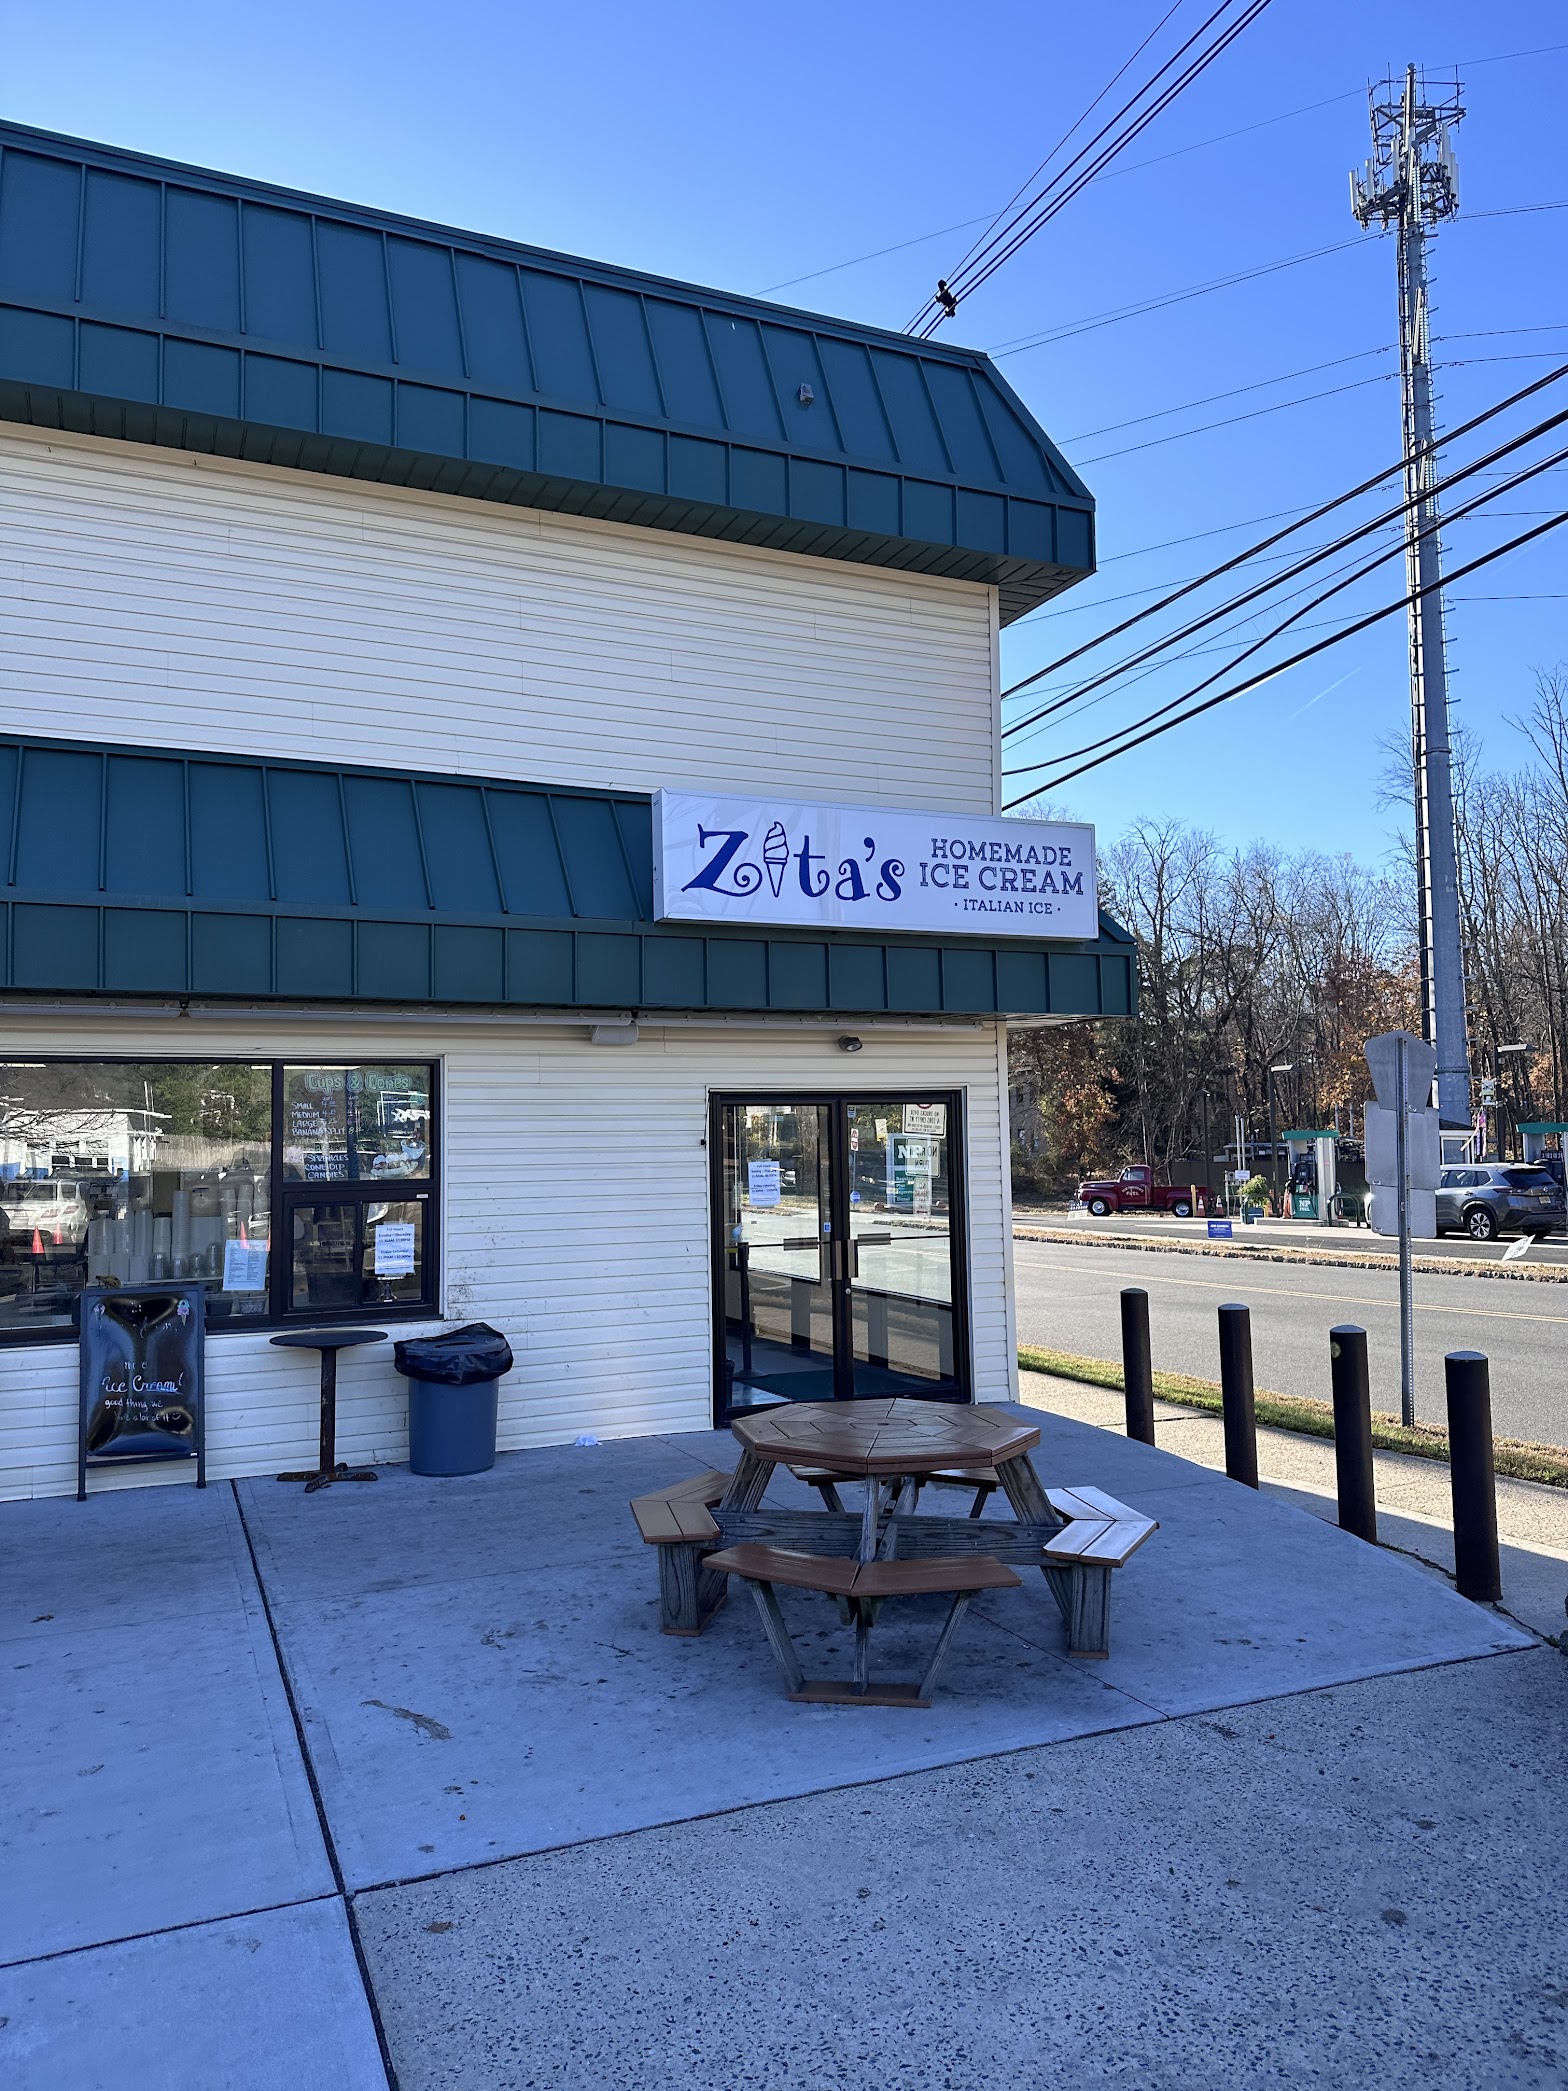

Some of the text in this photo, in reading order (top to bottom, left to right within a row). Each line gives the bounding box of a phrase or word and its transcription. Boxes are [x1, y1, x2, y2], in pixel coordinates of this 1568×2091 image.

[931, 838, 1072, 867] HOMEMADE
[919, 862, 1084, 896] ICE CREAM
[963, 898, 1053, 915] ITALIAN ICE
[306, 1072, 344, 1095] Cups
[367, 1072, 411, 1092] Cones
[291, 1101, 314, 1110] SMALL
[291, 1111, 320, 1119] MEDIUM
[292, 1120, 318, 1128] LARGE
[292, 1128, 323, 1136] BANANA
[328, 1163, 345, 1173] DIP
[307, 1172, 345, 1182] CANDIES
[1299, 1199, 1311, 1207] NP
[104, 1398, 124, 1410] good
